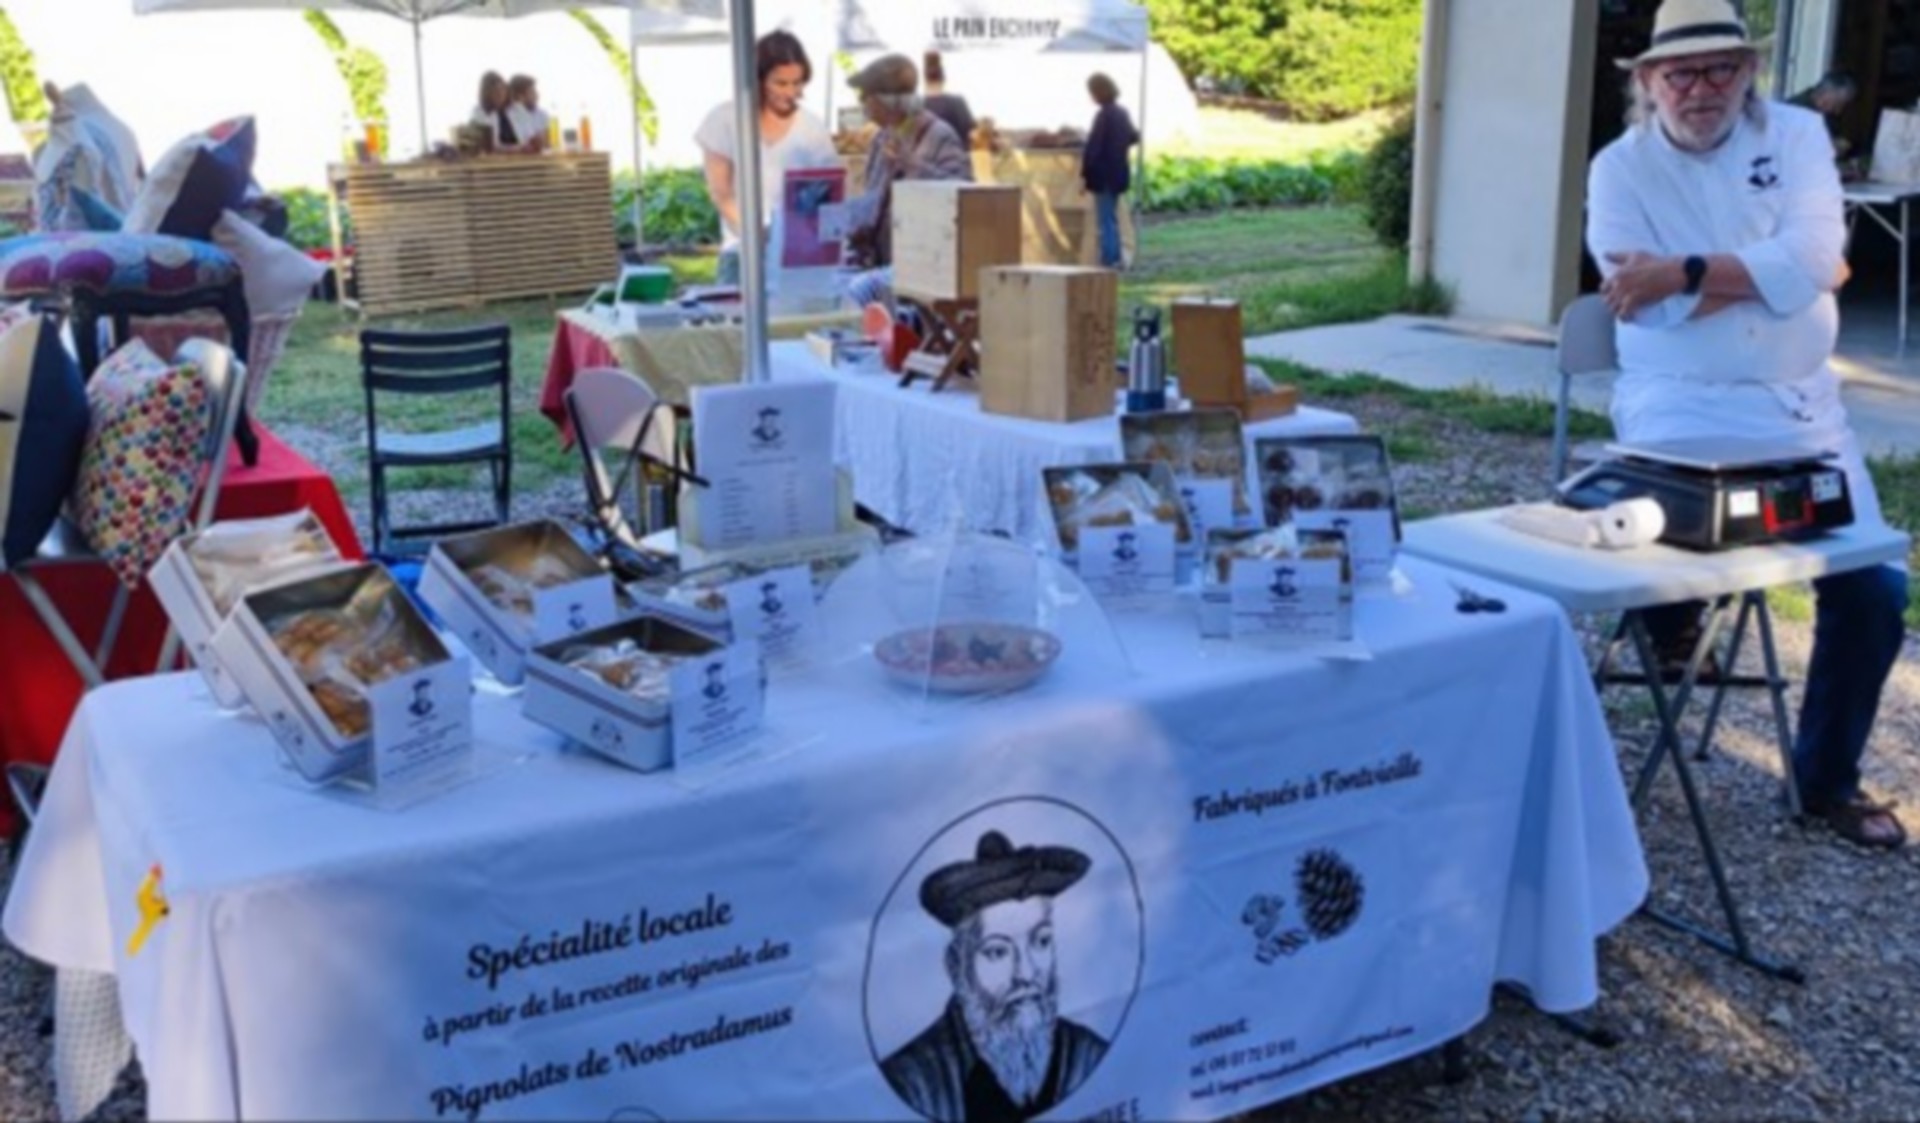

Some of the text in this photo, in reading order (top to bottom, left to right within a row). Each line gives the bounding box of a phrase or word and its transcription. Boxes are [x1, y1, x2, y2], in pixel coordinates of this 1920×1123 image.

[933, 17, 949, 38] LE
[954, 17, 986, 38] PAIN
[1193, 780, 1299, 822] Fabriqués
[1303, 774, 1318, 800] à
[466, 893, 732, 989] Spécialité locale
[422, 937, 790, 1046] à partir de la recette originale des
[429, 1005, 793, 1122] Pignolats de Nostradamus
